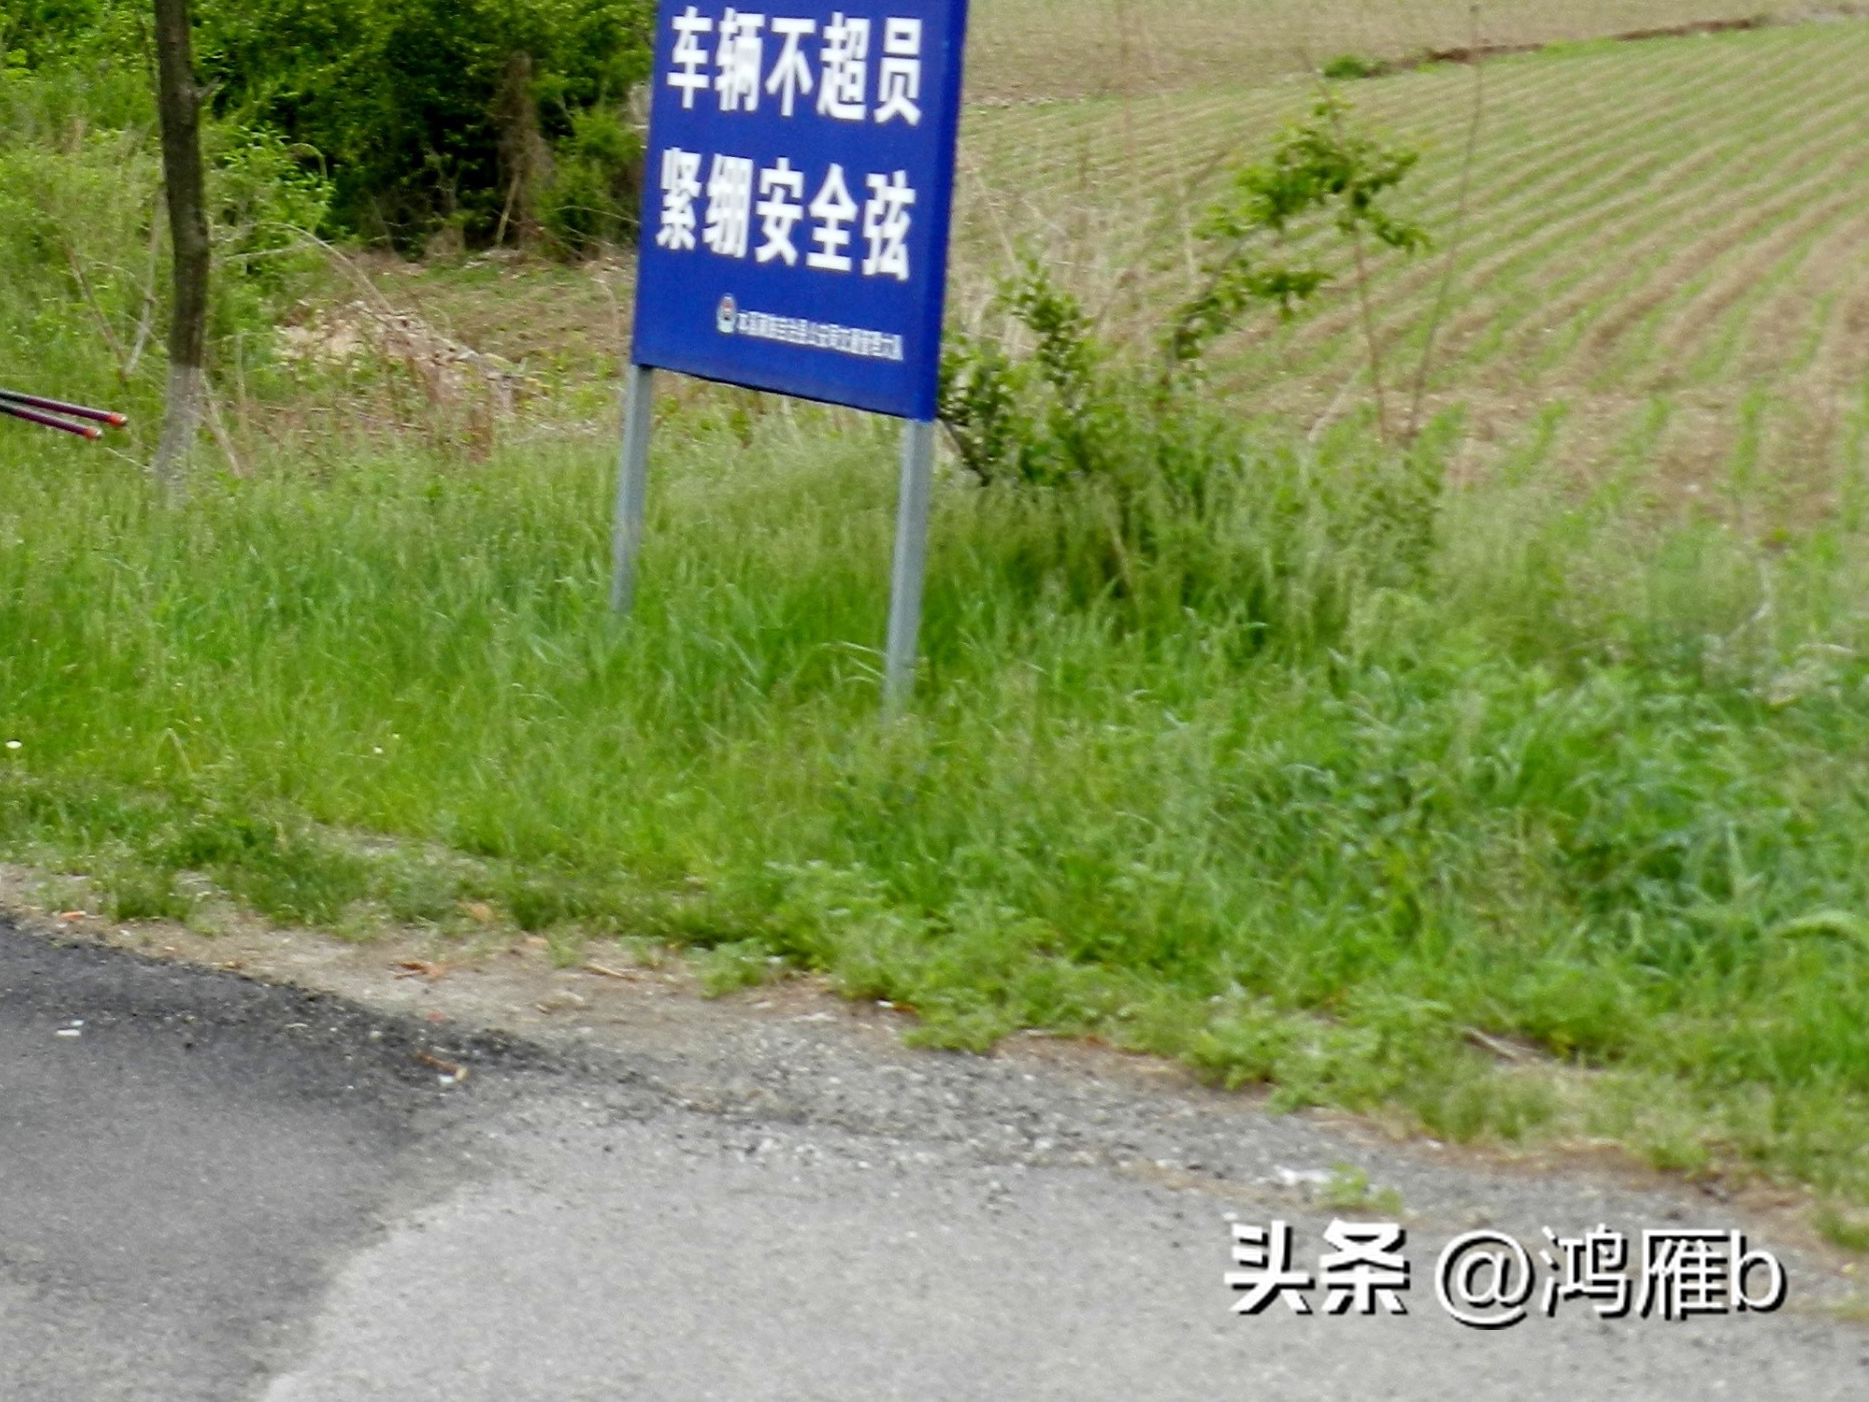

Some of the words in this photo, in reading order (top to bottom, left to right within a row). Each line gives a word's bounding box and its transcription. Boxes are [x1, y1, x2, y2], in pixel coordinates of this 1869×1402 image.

[666, 5, 923, 126] 车辆不超员
[655, 147, 916, 281] 紧绷安全弦
